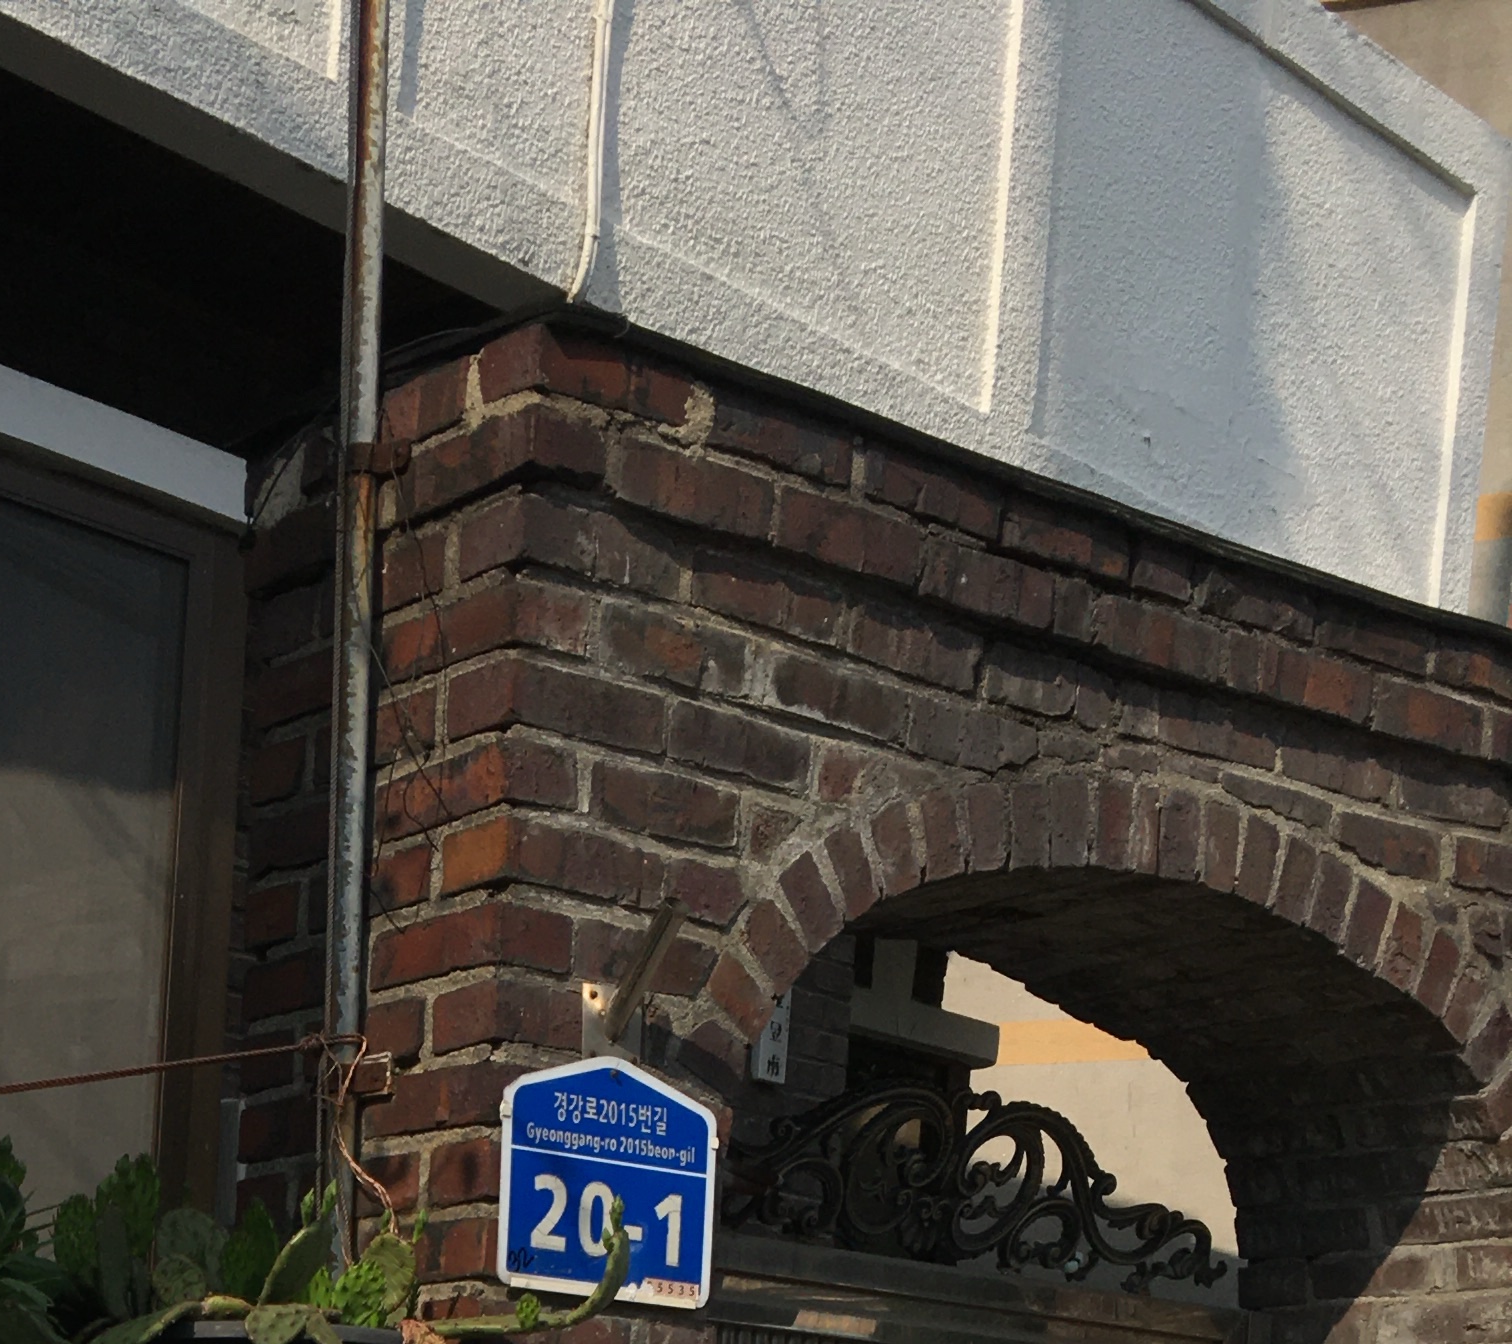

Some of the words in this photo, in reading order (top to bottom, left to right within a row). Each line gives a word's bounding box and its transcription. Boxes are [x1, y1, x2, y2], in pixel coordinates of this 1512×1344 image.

[553, 1091, 667, 1136] 경강로2015번길
[526, 1122, 617, 1153] Gyeonggang-ro
[620, 1137, 696, 1166] 2015beon-gil
[530, 1173, 683, 1267] 20-1
